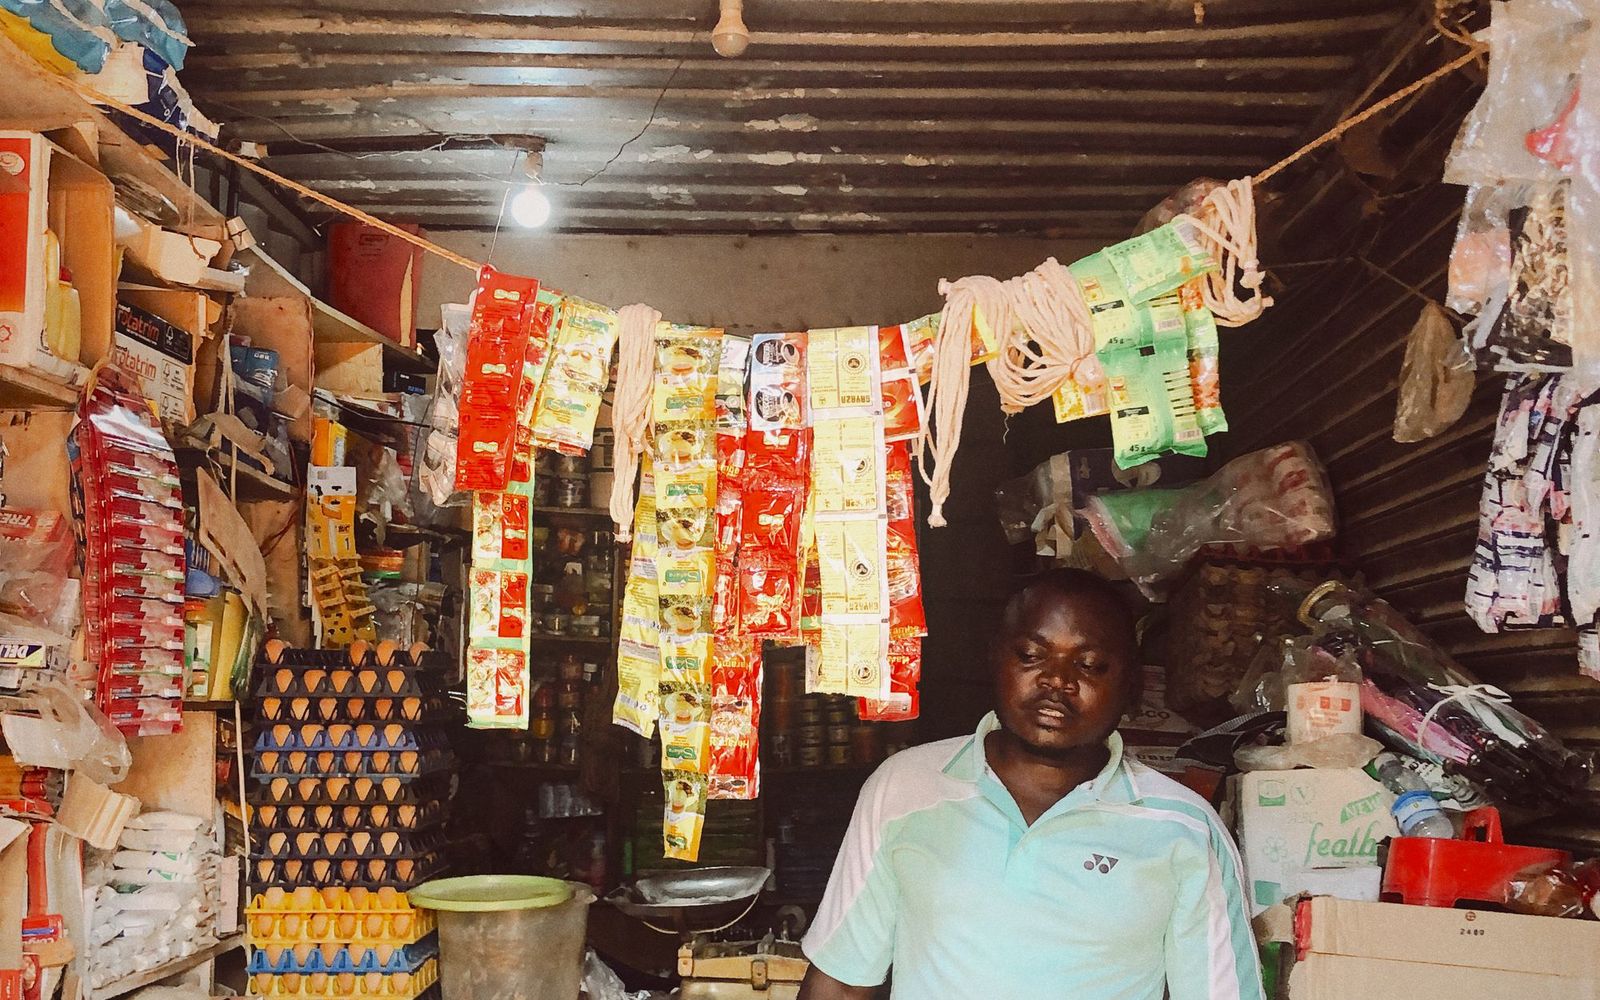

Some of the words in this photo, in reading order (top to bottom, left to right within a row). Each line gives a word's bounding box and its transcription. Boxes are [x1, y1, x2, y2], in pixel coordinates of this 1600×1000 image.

[118, 309, 160, 343] rotatrim
[1129, 444, 1140, 453] 45
[0, 512, 32, 528] FRE
